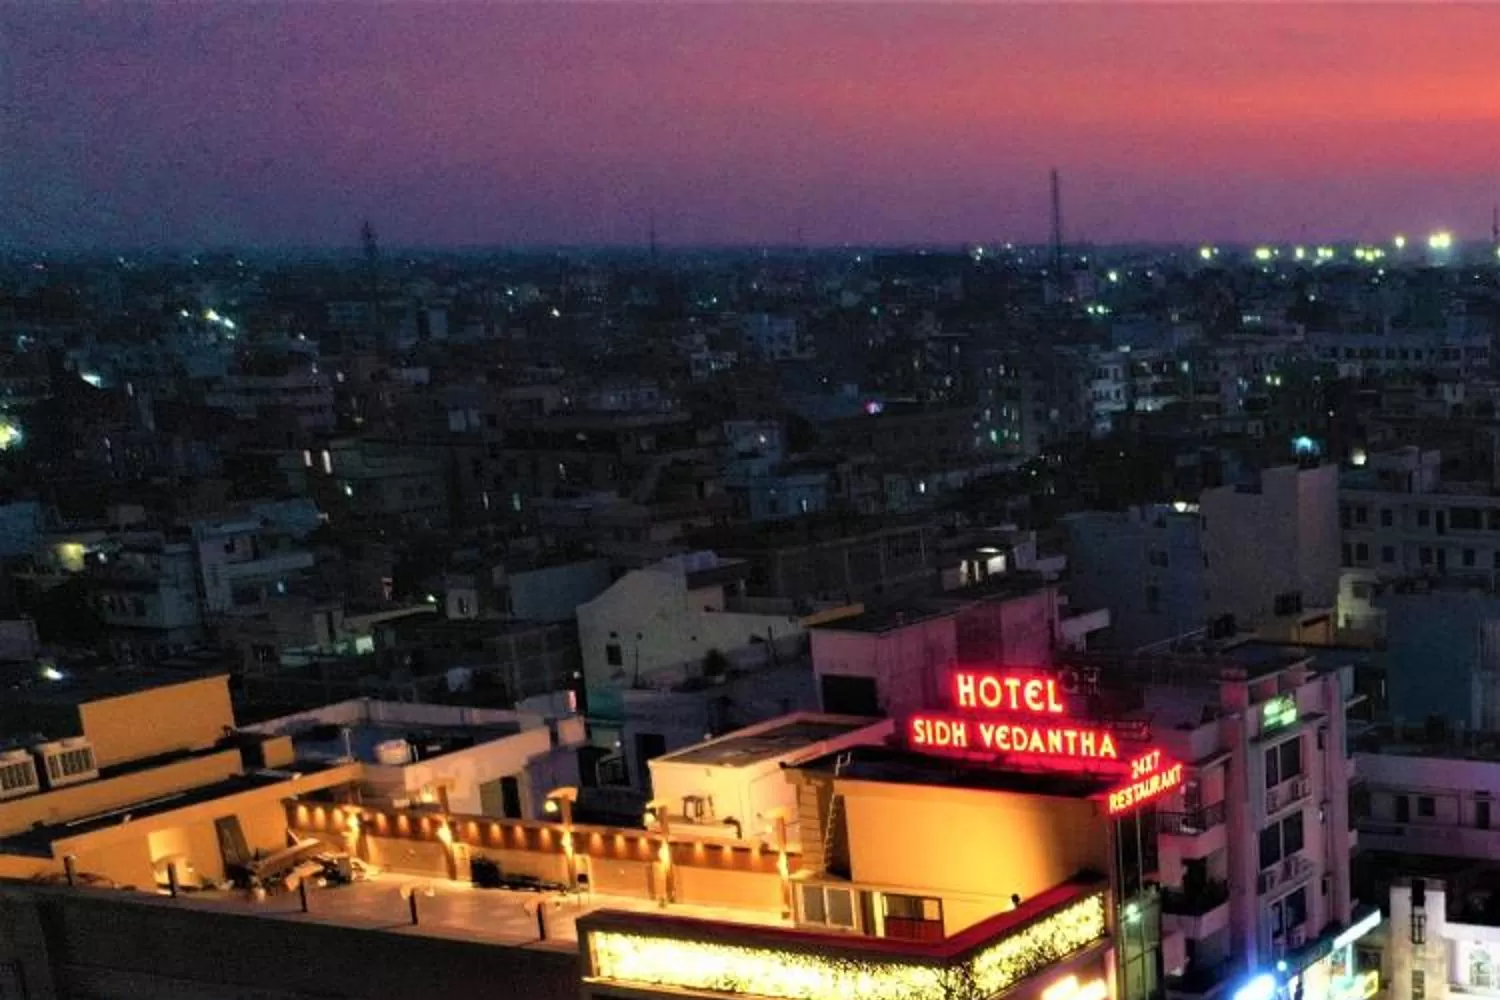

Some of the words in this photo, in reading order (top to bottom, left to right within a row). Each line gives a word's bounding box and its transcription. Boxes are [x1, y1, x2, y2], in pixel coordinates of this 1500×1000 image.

[956, 673, 1064, 713] HOTEL
[913, 719, 967, 747] SIDH
[980, 723, 1117, 758] VEDANTHA
[1109, 763, 1182, 814] RESTAURANT
